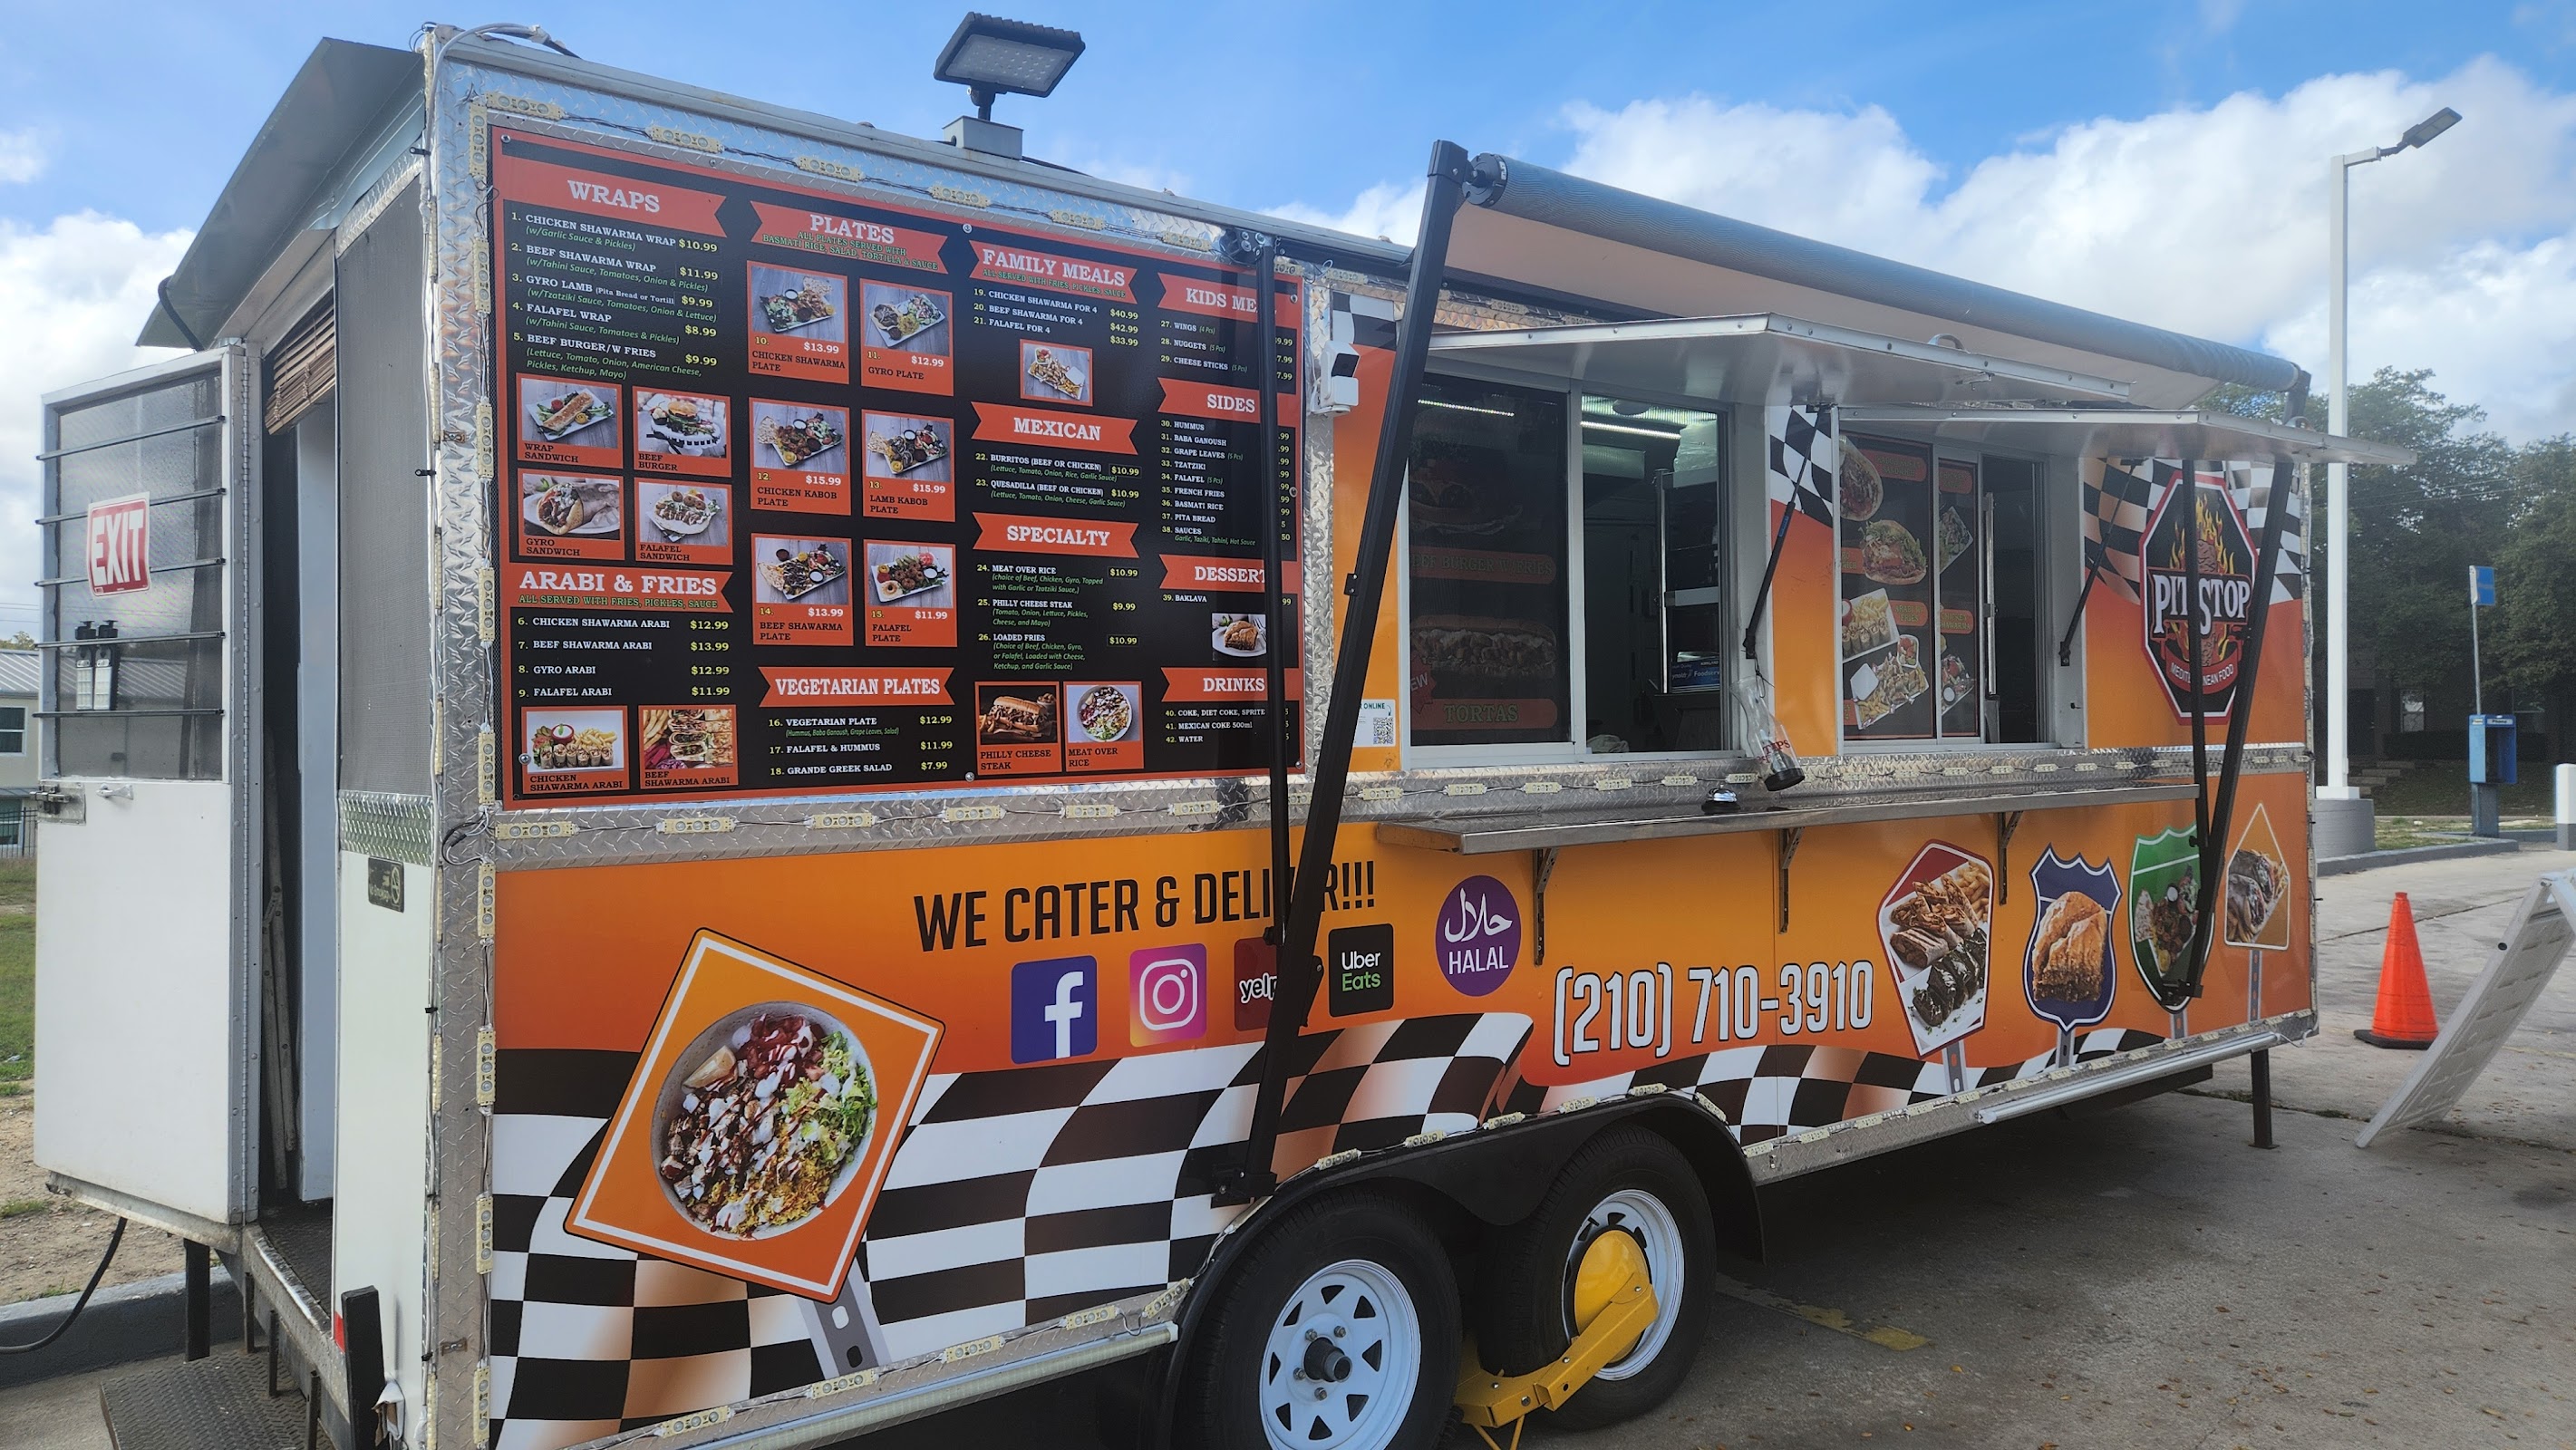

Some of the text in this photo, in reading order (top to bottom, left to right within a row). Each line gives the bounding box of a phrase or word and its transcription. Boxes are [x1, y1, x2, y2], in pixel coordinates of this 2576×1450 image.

[567, 179, 660, 213] WRAPS
[526, 214, 576, 230] CHICKEN
[580, 223, 643, 241] SHAWARMA
[645, 234, 676, 246] WRAP
[679, 238, 717, 252] $10.99
[810, 215, 895, 244] PLATES
[526, 226, 636, 251] (w/Garlic Sauce & Pickles)
[511, 243, 718, 281] 2. BEEF SHAWARMA WRAP $11.99
[983, 248, 1125, 286] FAMILY MEALS
[974, 288, 986, 296] 19.
[988, 291, 1025, 303] CHICKEN
[1028, 297, 1072, 309] SHAWARMA
[1075, 304, 1090, 313] FOR
[1110, 308, 1138, 319] $40.99
[1186, 287, 1226, 307] KIDS
[512, 302, 716, 337] 4. FALAFEL WRAP $8.99
[974, 317, 986, 325] 21.
[989, 319, 1024, 330] FALAFEL
[1027, 324, 1043, 334] FOR
[1110, 335, 1138, 346] $33.99
[513, 333, 717, 366] 5. BEEF BURGER/W FRIES $9.99
[755, 336, 839, 354] 10. $13.99
[752, 351, 846, 369] CHICKEN SHAWARMA
[752, 362, 780, 372] PLATE
[867, 352, 944, 367] 11. $12.99
[868, 367, 924, 380] GYRO PLATE
[1207, 394, 1254, 412] SIDES
[1013, 417, 1100, 440] MEXICAN
[524, 443, 554, 452] WRAP
[525, 451, 578, 462] SANDWICH
[638, 453, 663, 461] BEEF
[991, 454, 1029, 464] BURRITOS
[1031, 459, 1052, 468] (BEEF
[1054, 459, 1065, 468] OR
[1067, 460, 1101, 471] CHICKEN)
[1111, 466, 1139, 476] $10.99
[638, 461, 677, 471] BURGER
[757, 472, 841, 485] 12. $15.99
[757, 487, 837, 499] CHICKEN KABOB
[1175, 488, 1202, 496] FRENCH
[758, 498, 788, 507] PLATE
[1175, 500, 1205, 509] BASMATI
[527, 537, 555, 546] GYRO
[1007, 526, 1110, 546] SPECIALTY
[92, 509, 144, 586] EXIT
[527, 546, 580, 556] SANDWICH
[640, 544, 682, 552] FALAFEL
[640, 552, 690, 561] SANDWICH
[1442, 556, 1495, 572] BURGER
[993, 565, 1013, 573] MEAT
[1015, 566, 1036, 574] OVER
[1110, 568, 1138, 577] $10.99
[519, 571, 717, 594] ARABI & FRIES
[993, 599, 1018, 607] PHILLY
[1020, 600, 1048, 609] CHEESE
[1051, 601, 1072, 609] STEAK
[1113, 603, 1136, 611] $9.99
[1176, 594, 1207, 603] BAKLAVA
[2153, 575, 2250, 634] PIT STOP
[518, 617, 728, 630] 6. CHICKEN SHAWARMA ARABI $12.99
[872, 610, 947, 620] 15. $11.99
[518, 665, 729, 676] 8. GYRO ARABI $12.99
[2219, 664, 2233, 681] FOOD
[775, 679, 940, 695] VEGETARIAN PLATES
[1203, 677, 1264, 692] DRINKS
[1411, 672, 1428, 691] EW
[769, 716, 952, 727] 16. VEGETARIAN PLATE $12.99
[1444, 704, 1518, 722] TORTAS
[787, 766, 827, 775] GRANDE
[829, 765, 861, 773] GREEK
[864, 764, 892, 772] SALAD
[921, 761, 947, 770] $7.99
[914, 861, 1375, 952] WE CATER & DELIR!!!
[1445, 888, 1513, 942] حلال
[1341, 951, 1380, 970] Uber
[1448, 946, 1508, 974] HALAL
[1341, 972, 1381, 991] Eats
[1553, 961, 1874, 1067] (210) 710-3910
